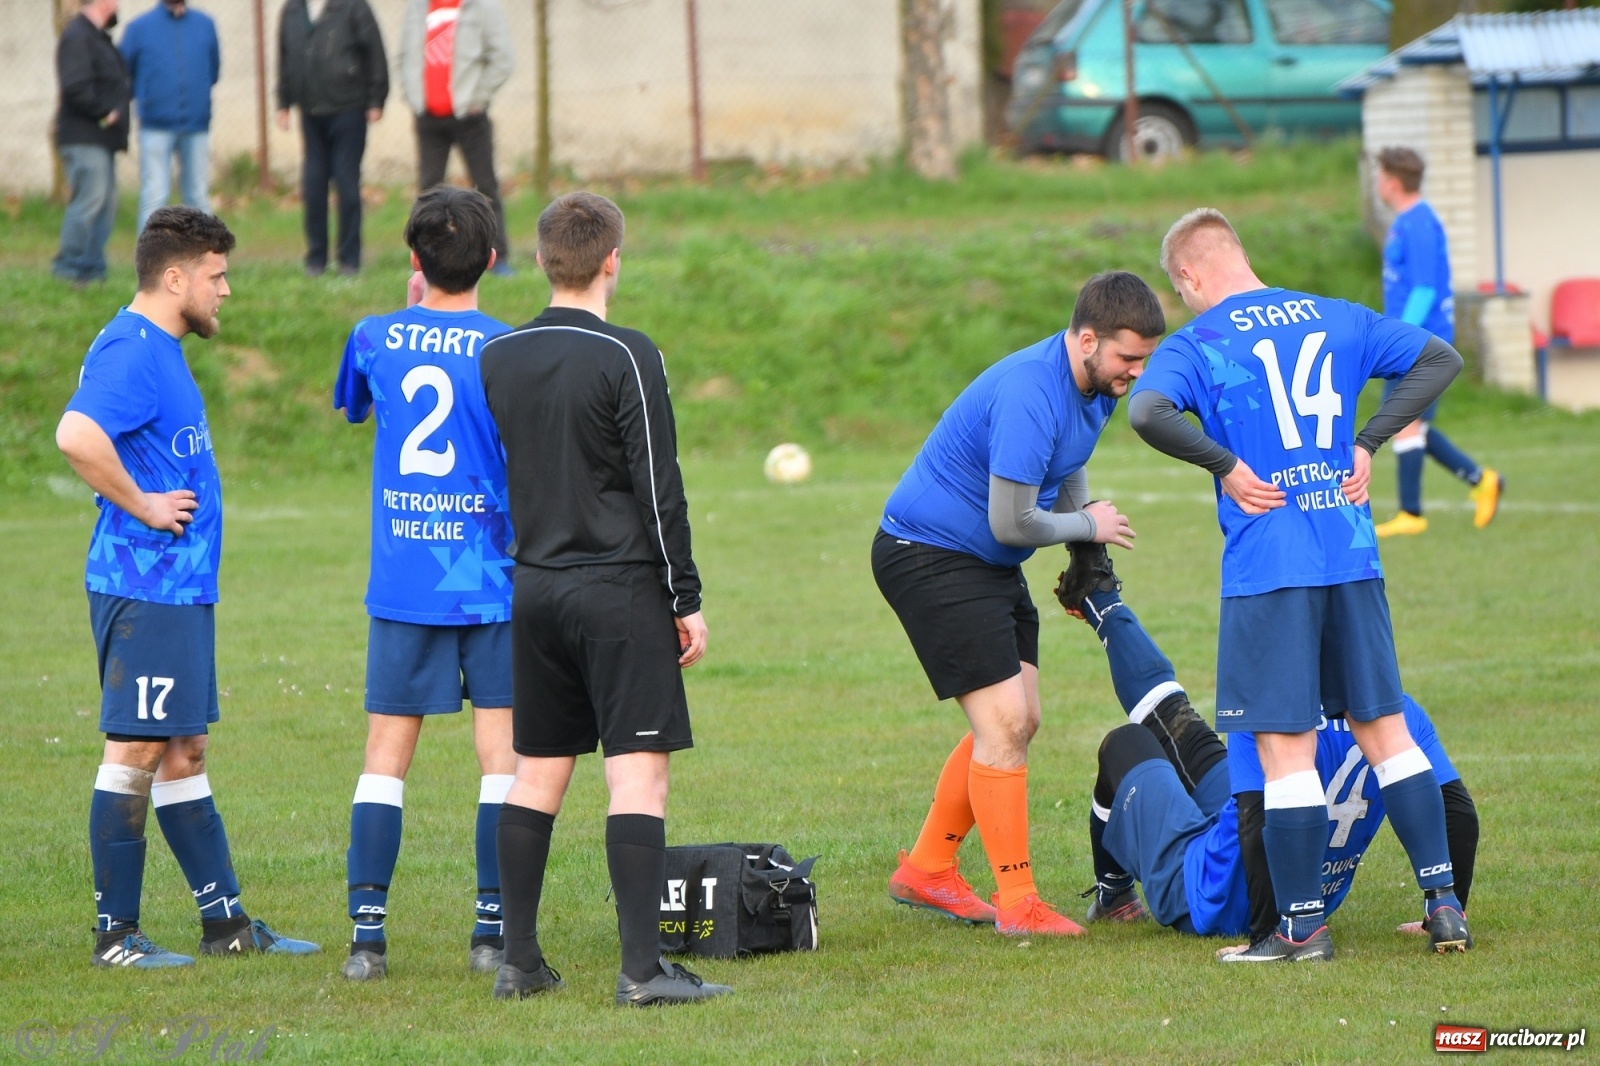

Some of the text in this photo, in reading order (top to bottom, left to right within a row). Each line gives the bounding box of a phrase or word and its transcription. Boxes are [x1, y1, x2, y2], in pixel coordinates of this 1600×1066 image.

[1229, 299, 1323, 332] START
[385, 322, 485, 358] START
[1251, 331, 1343, 451] 14
[399, 364, 456, 478] 2
[383, 487, 486, 513] PIETROWICE
[391, 518, 465, 541] WIELKIE
[135, 675, 175, 722] 17
[1217, 709, 1244, 717] COLO
[1420, 862, 1453, 878] COL
[1289, 899, 1325, 912] COL
